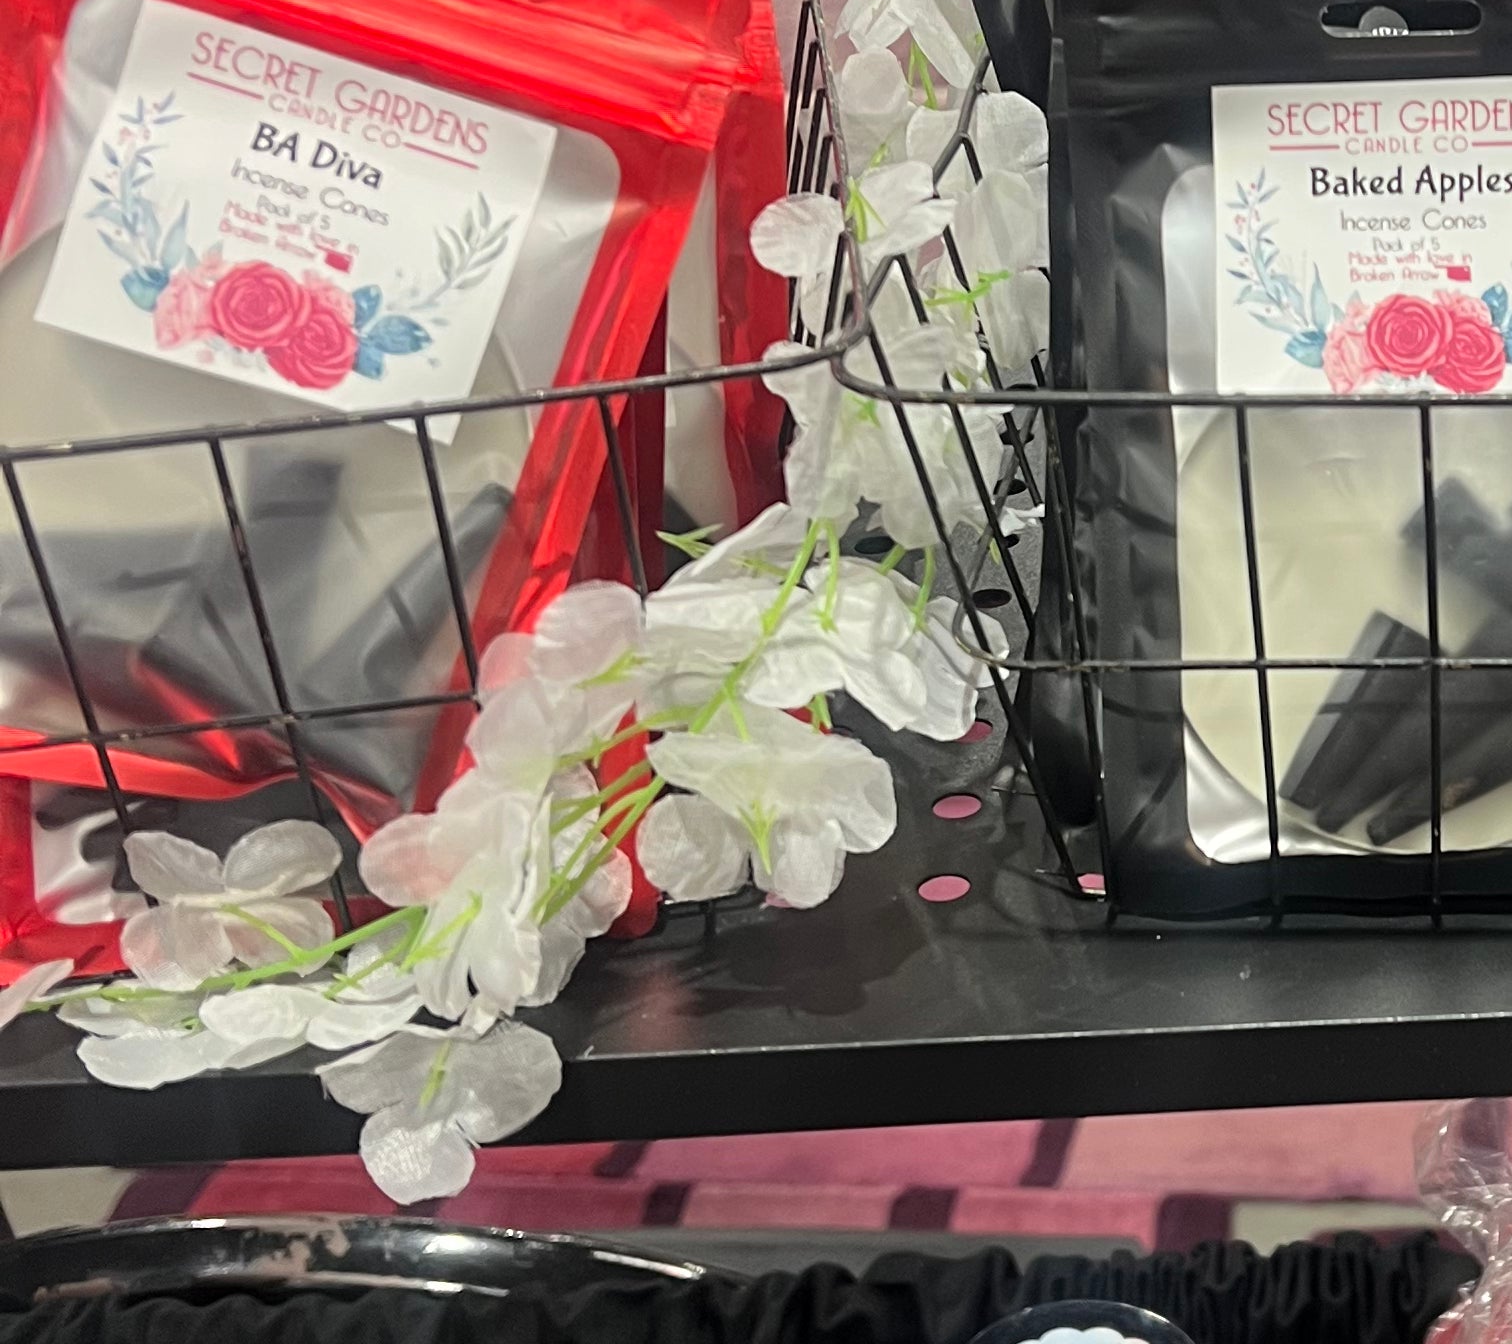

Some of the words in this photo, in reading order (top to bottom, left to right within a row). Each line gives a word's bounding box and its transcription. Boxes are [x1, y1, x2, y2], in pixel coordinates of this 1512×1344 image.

[190, 31, 323, 99] SECRET
[334, 79, 489, 155] GARDENS
[268, 92, 355, 135] CANDLE
[361, 124, 402, 149] CO
[1267, 101, 1382, 136] SECRET
[252, 121, 300, 162] BA
[310, 139, 383, 189] Diva
[1345, 137, 1423, 155] CANDLE
[1434, 135, 1468, 153] CO
[230, 158, 310, 200] Incense
[319, 187, 390, 226] Cones
[1310, 165, 1403, 197] Baked
[1340, 210, 1411, 232] Incense
[1422, 209, 1487, 230] Cones
[1372, 237, 1403, 252] Pack
[1410, 237, 1428, 252] of
[1431, 237, 1440, 251] 5
[1350, 267, 1395, 283] Broken
[1402, 266, 1440, 281] Arrow
